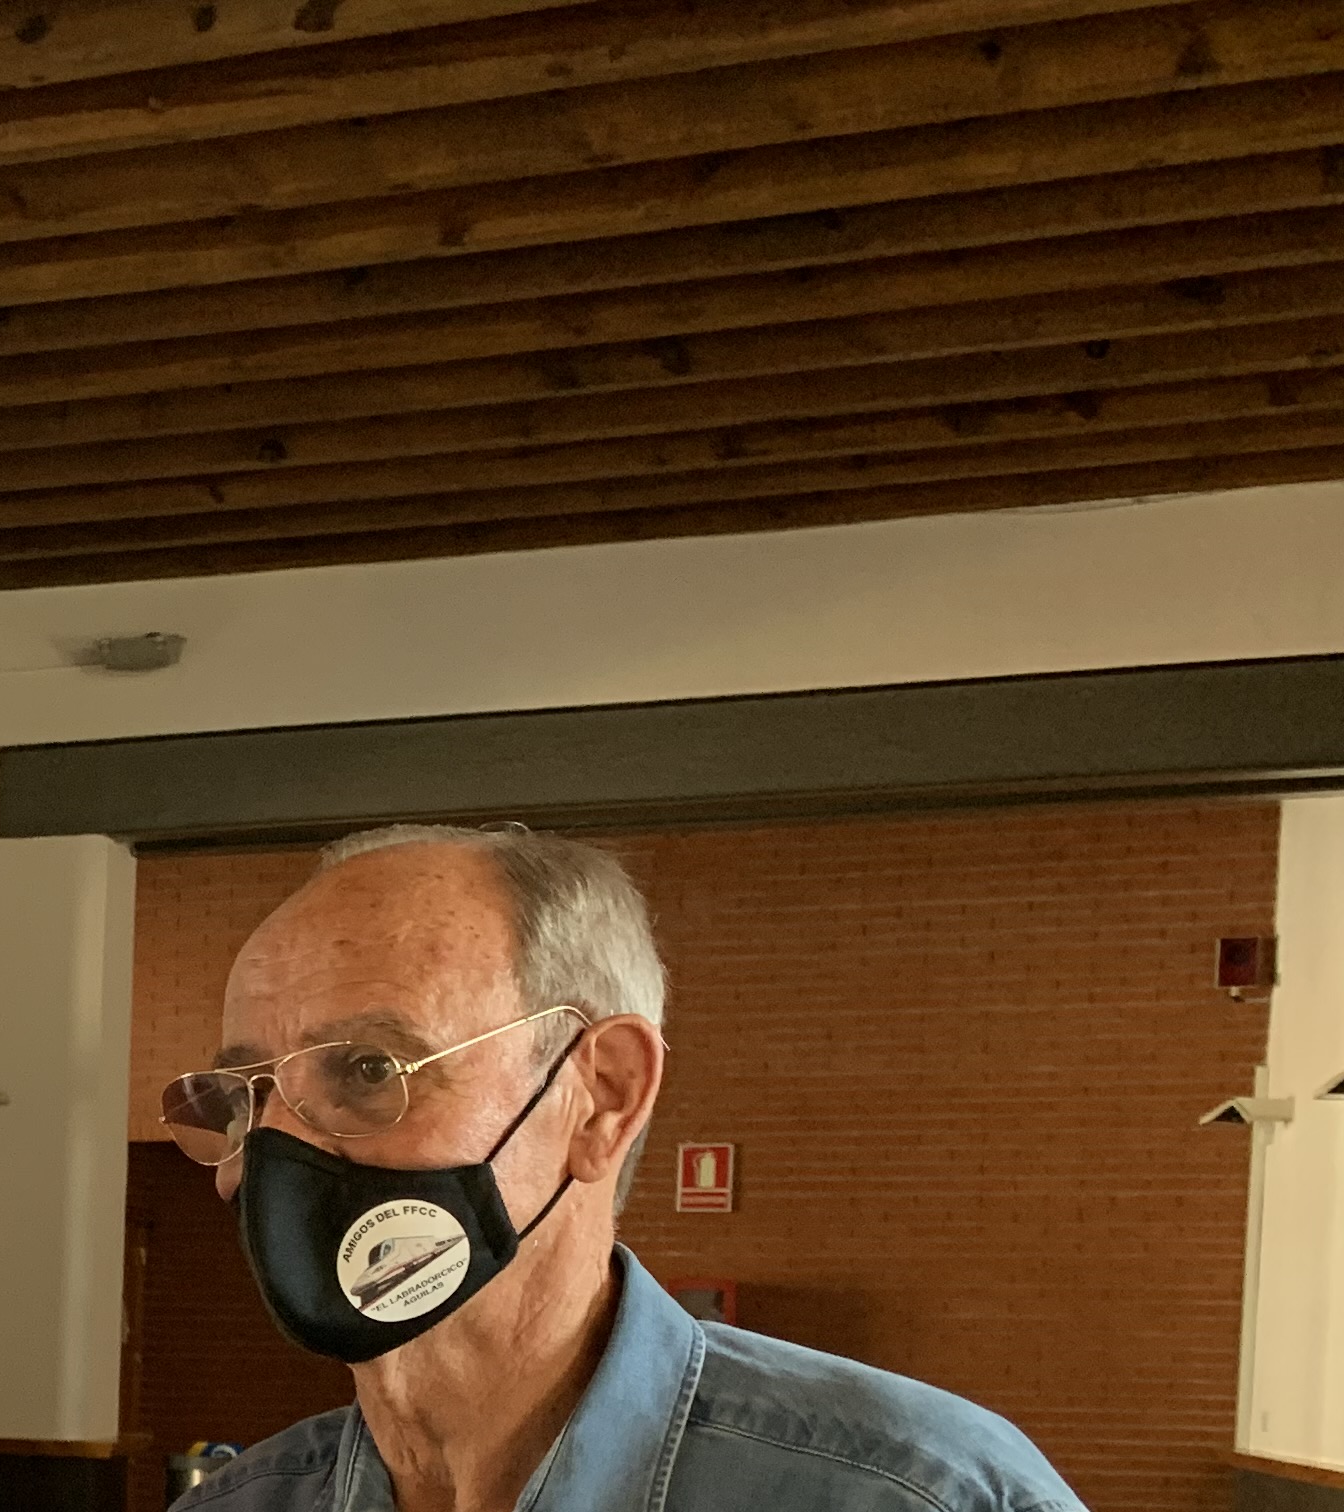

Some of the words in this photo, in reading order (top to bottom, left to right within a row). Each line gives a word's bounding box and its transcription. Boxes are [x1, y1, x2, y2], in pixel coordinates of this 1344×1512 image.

[342, 1219, 375, 1263] AMIGOS
[375, 1208, 400, 1223] DEL
[403, 1205, 438, 1218] FFCC
